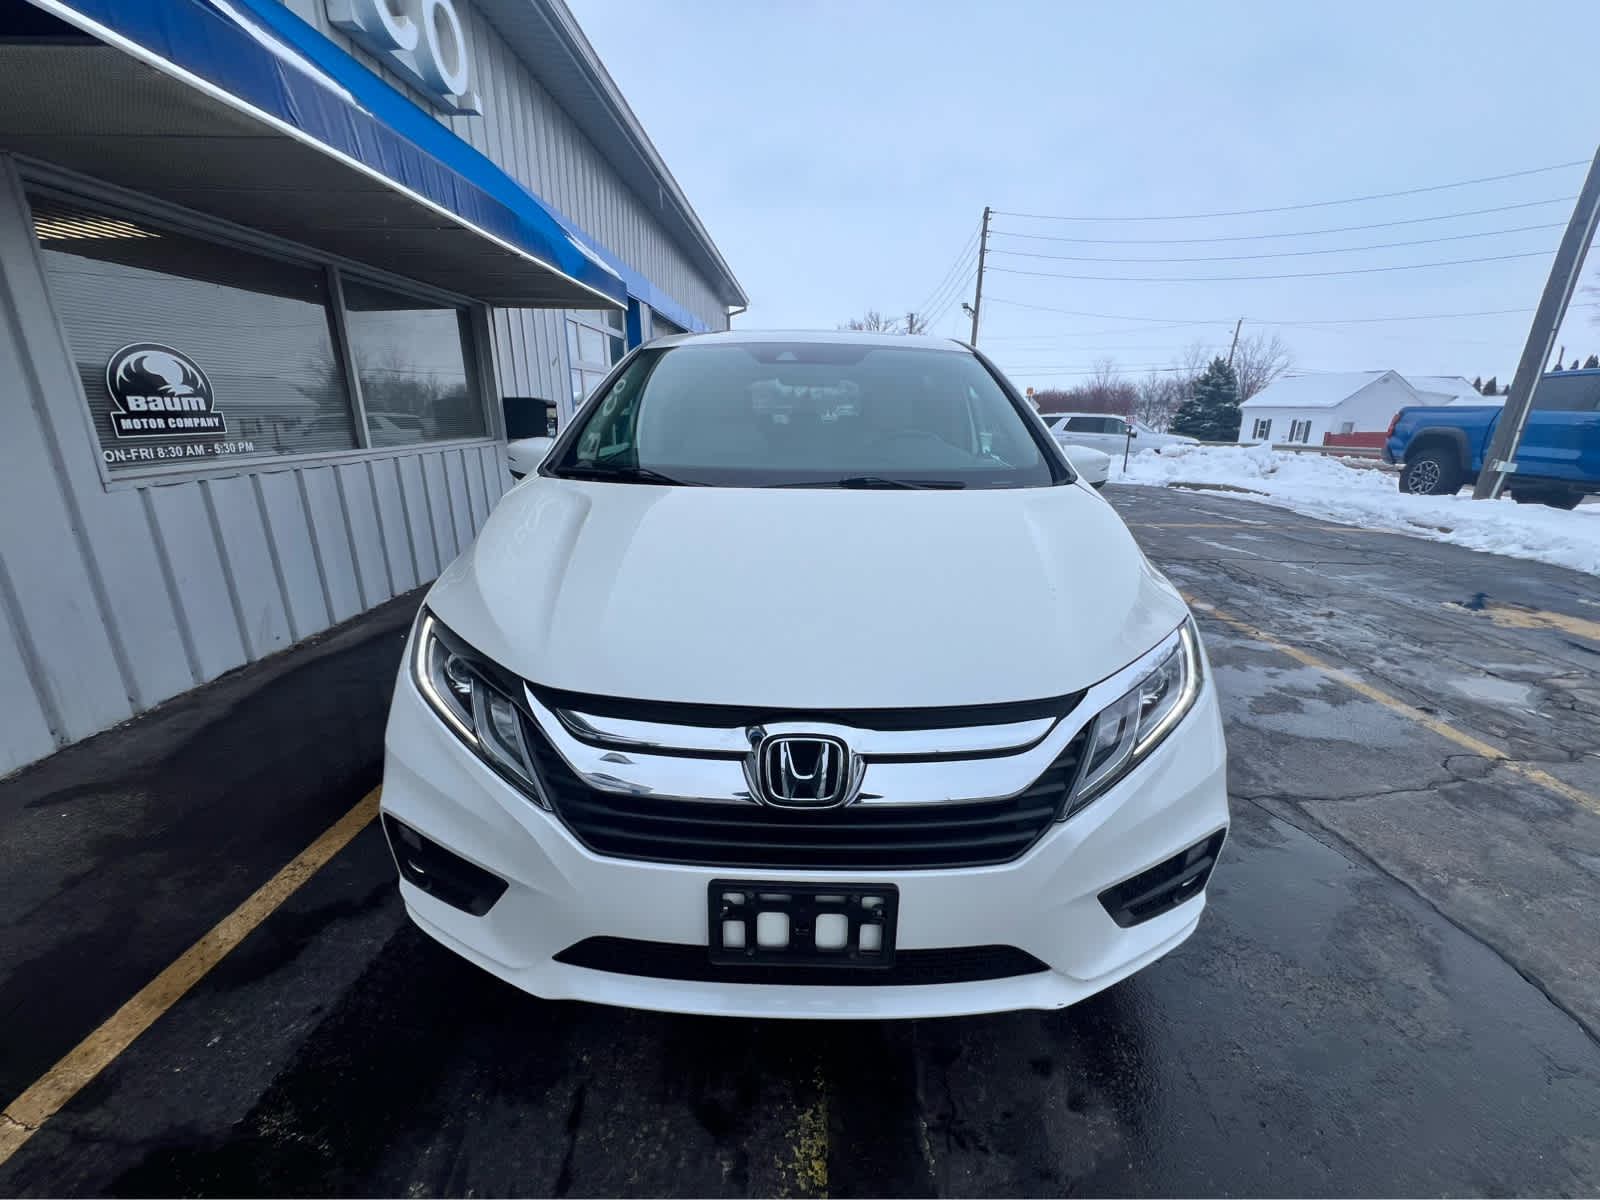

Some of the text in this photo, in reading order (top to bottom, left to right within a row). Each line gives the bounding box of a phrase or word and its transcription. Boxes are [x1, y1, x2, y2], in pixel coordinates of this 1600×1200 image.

[126, 395, 206, 412] Baum
[120, 417, 219, 430] MOTOR COMPANY
[103, 449, 154, 463] ON-FRI
[157, 446, 183, 458] 8:30
[186, 444, 205, 456] AM
[214, 442, 236, 454] 5:30
[238, 441, 254, 452] PM
